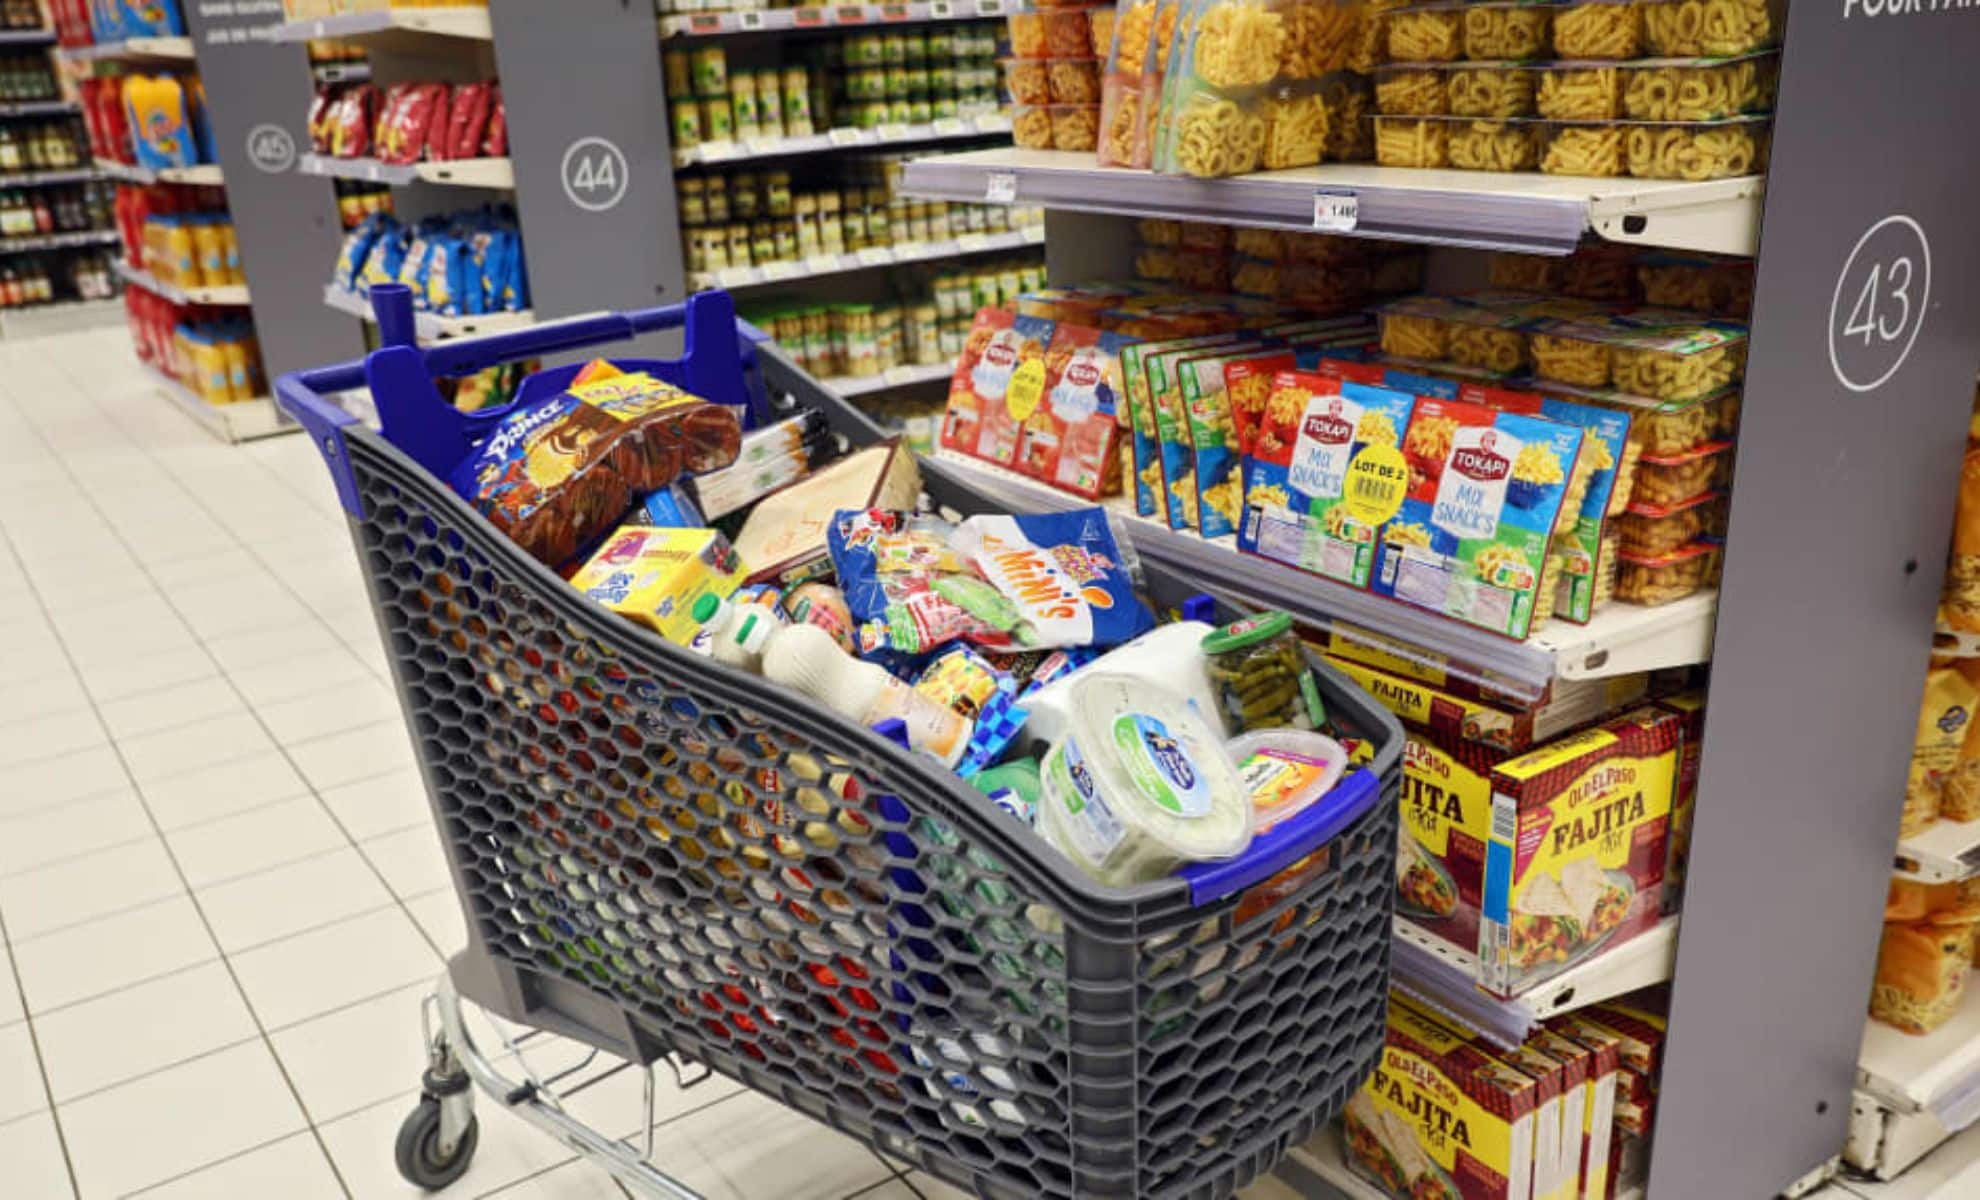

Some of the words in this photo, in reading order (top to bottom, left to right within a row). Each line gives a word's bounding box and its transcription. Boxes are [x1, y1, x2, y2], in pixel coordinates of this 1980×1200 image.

[574, 154, 616, 193] 44
[1843, 257, 1912, 347] 43
[1354, 459, 1377, 473] LOT
[1378, 464, 1395, 478] DE
[1396, 470, 1405, 480] 2
[1457, 451, 1507, 475] TOKAPI
[1455, 483, 1485, 506] MIX
[1372, 679, 1423, 707] FAJITA
[1400, 774, 1465, 825] JITA
[1552, 791, 1645, 857] FAJITA
[1373, 1069, 1473, 1149] FAJITA
